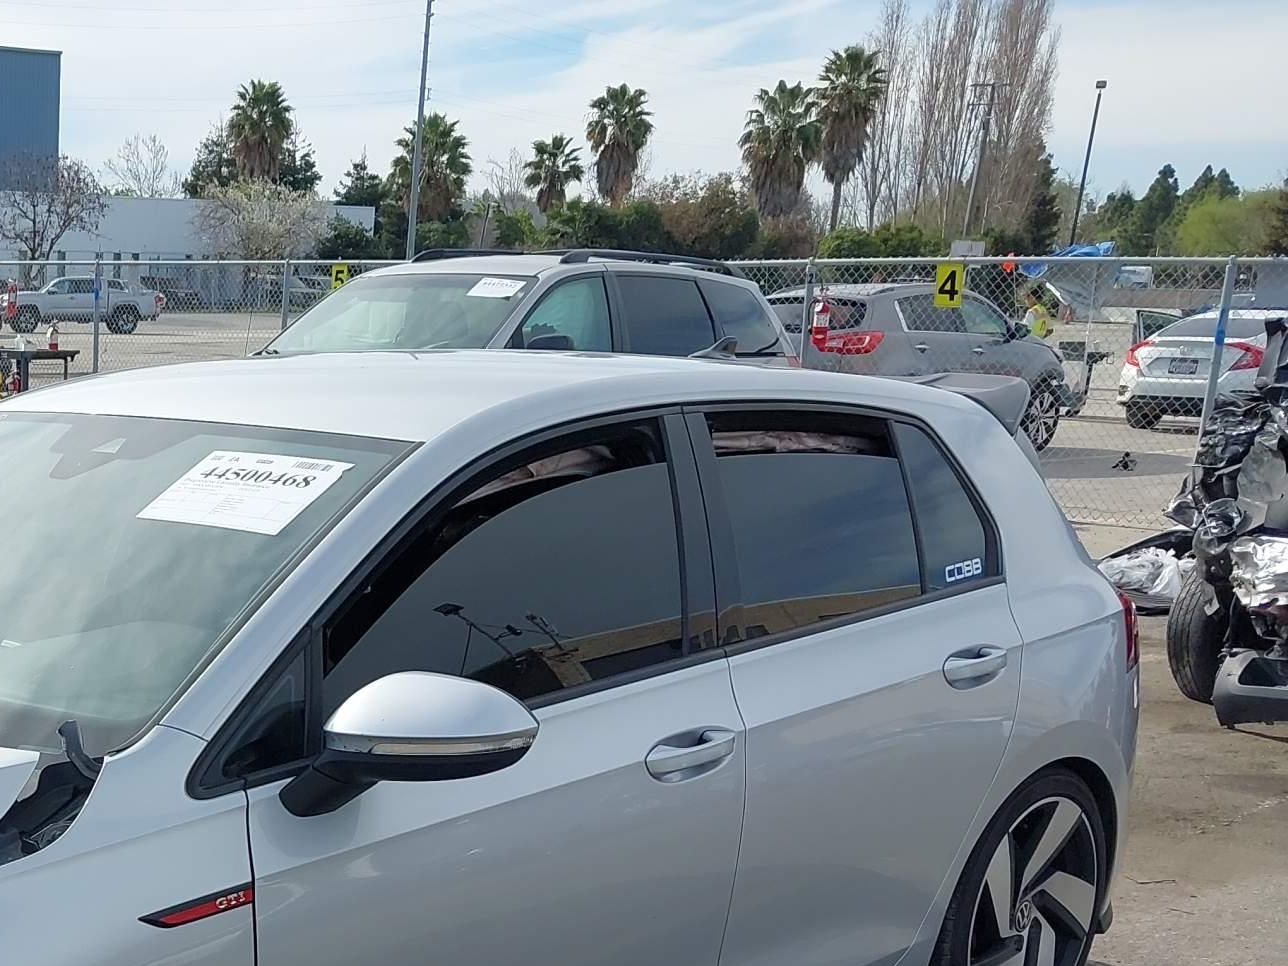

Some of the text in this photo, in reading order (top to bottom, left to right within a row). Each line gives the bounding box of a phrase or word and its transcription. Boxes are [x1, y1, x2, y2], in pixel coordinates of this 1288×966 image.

[334, 269, 345, 289] 5
[938, 269, 959, 301] 4
[199, 465, 318, 490] 44500468
[945, 557, 982, 583] COBB
[215, 890, 247, 909] GTI
